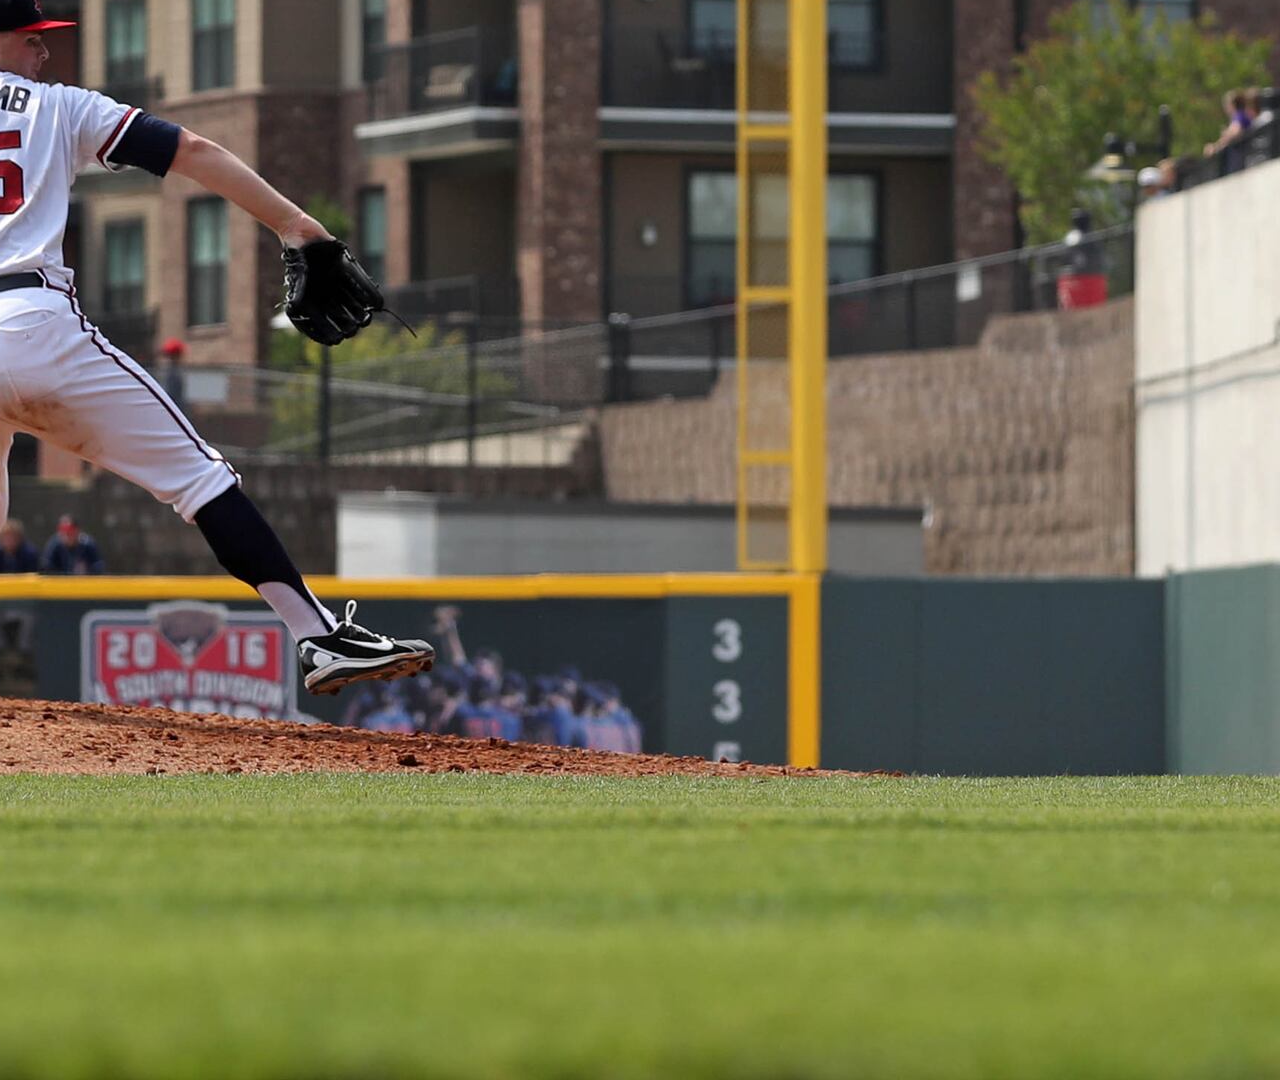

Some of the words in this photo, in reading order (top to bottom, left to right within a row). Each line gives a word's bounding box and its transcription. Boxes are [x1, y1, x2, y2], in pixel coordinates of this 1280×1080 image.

[107, 631, 156, 668] 20
[227, 631, 267, 668] 16
[115, 670, 188, 702] SOUTH
[196, 670, 283, 708] DIVISION
